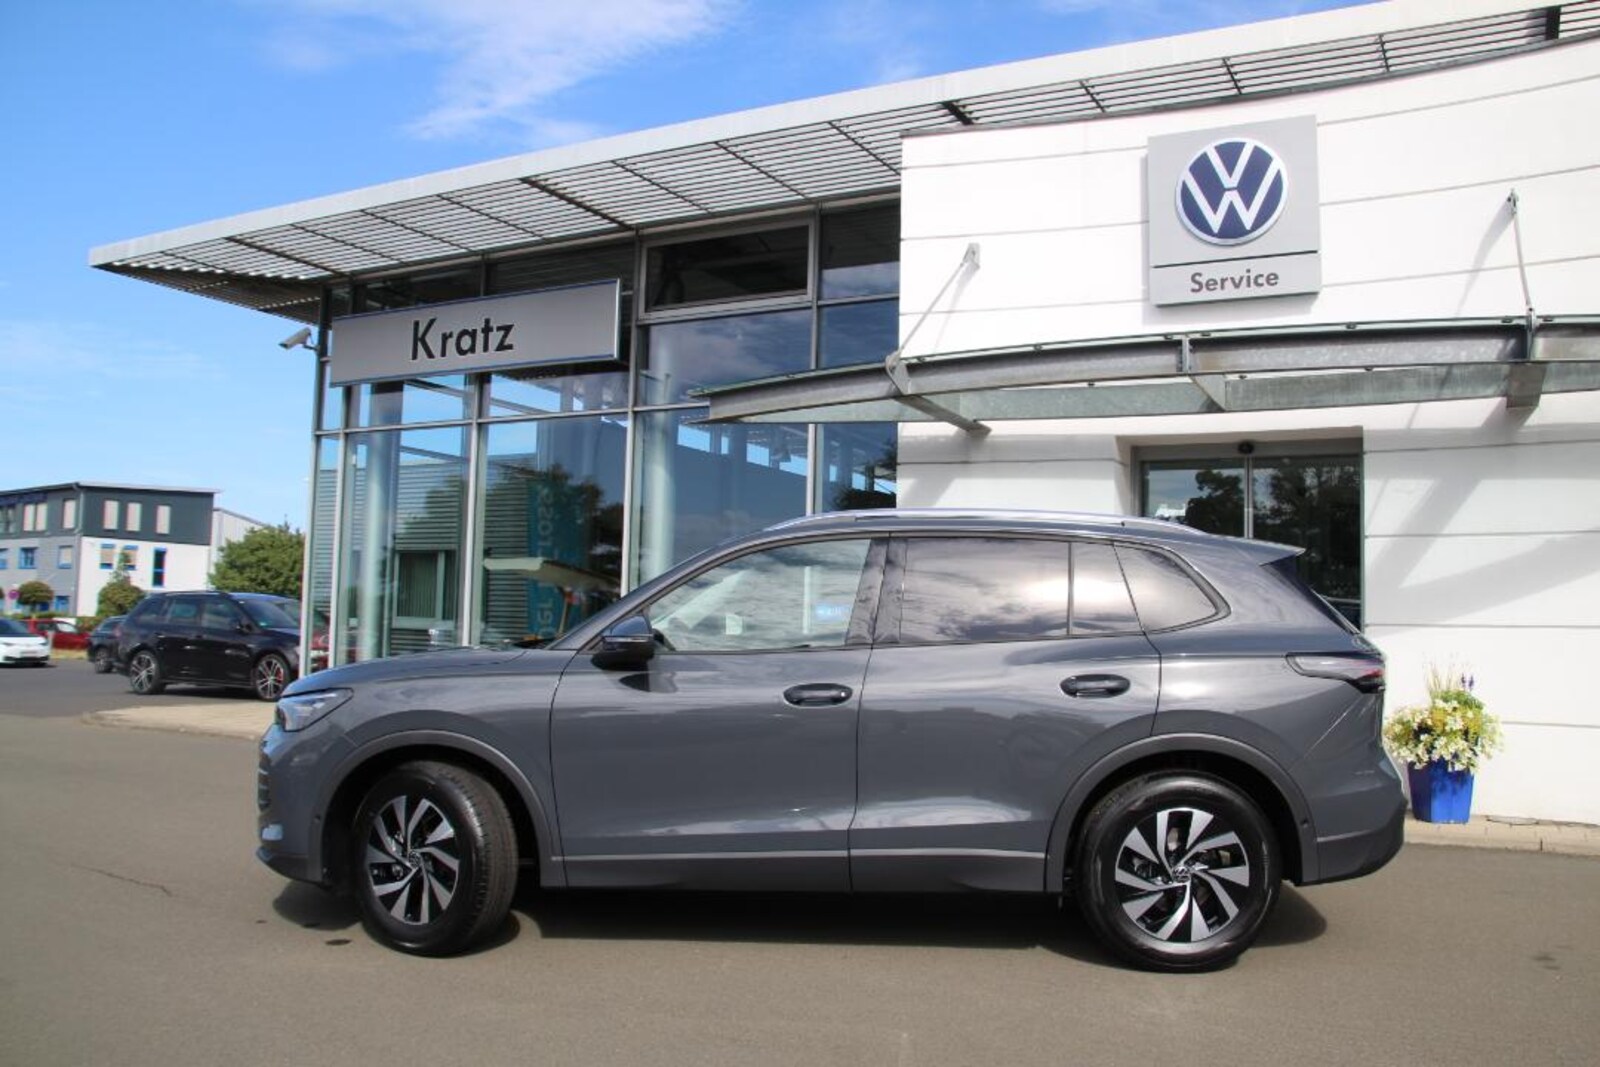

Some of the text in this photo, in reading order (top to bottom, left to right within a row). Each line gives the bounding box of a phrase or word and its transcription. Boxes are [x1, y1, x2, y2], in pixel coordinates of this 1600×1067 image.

[1181, 140, 1284, 237] VW
[1190, 269, 1280, 293] Service
[410, 317, 515, 361] Kratz
